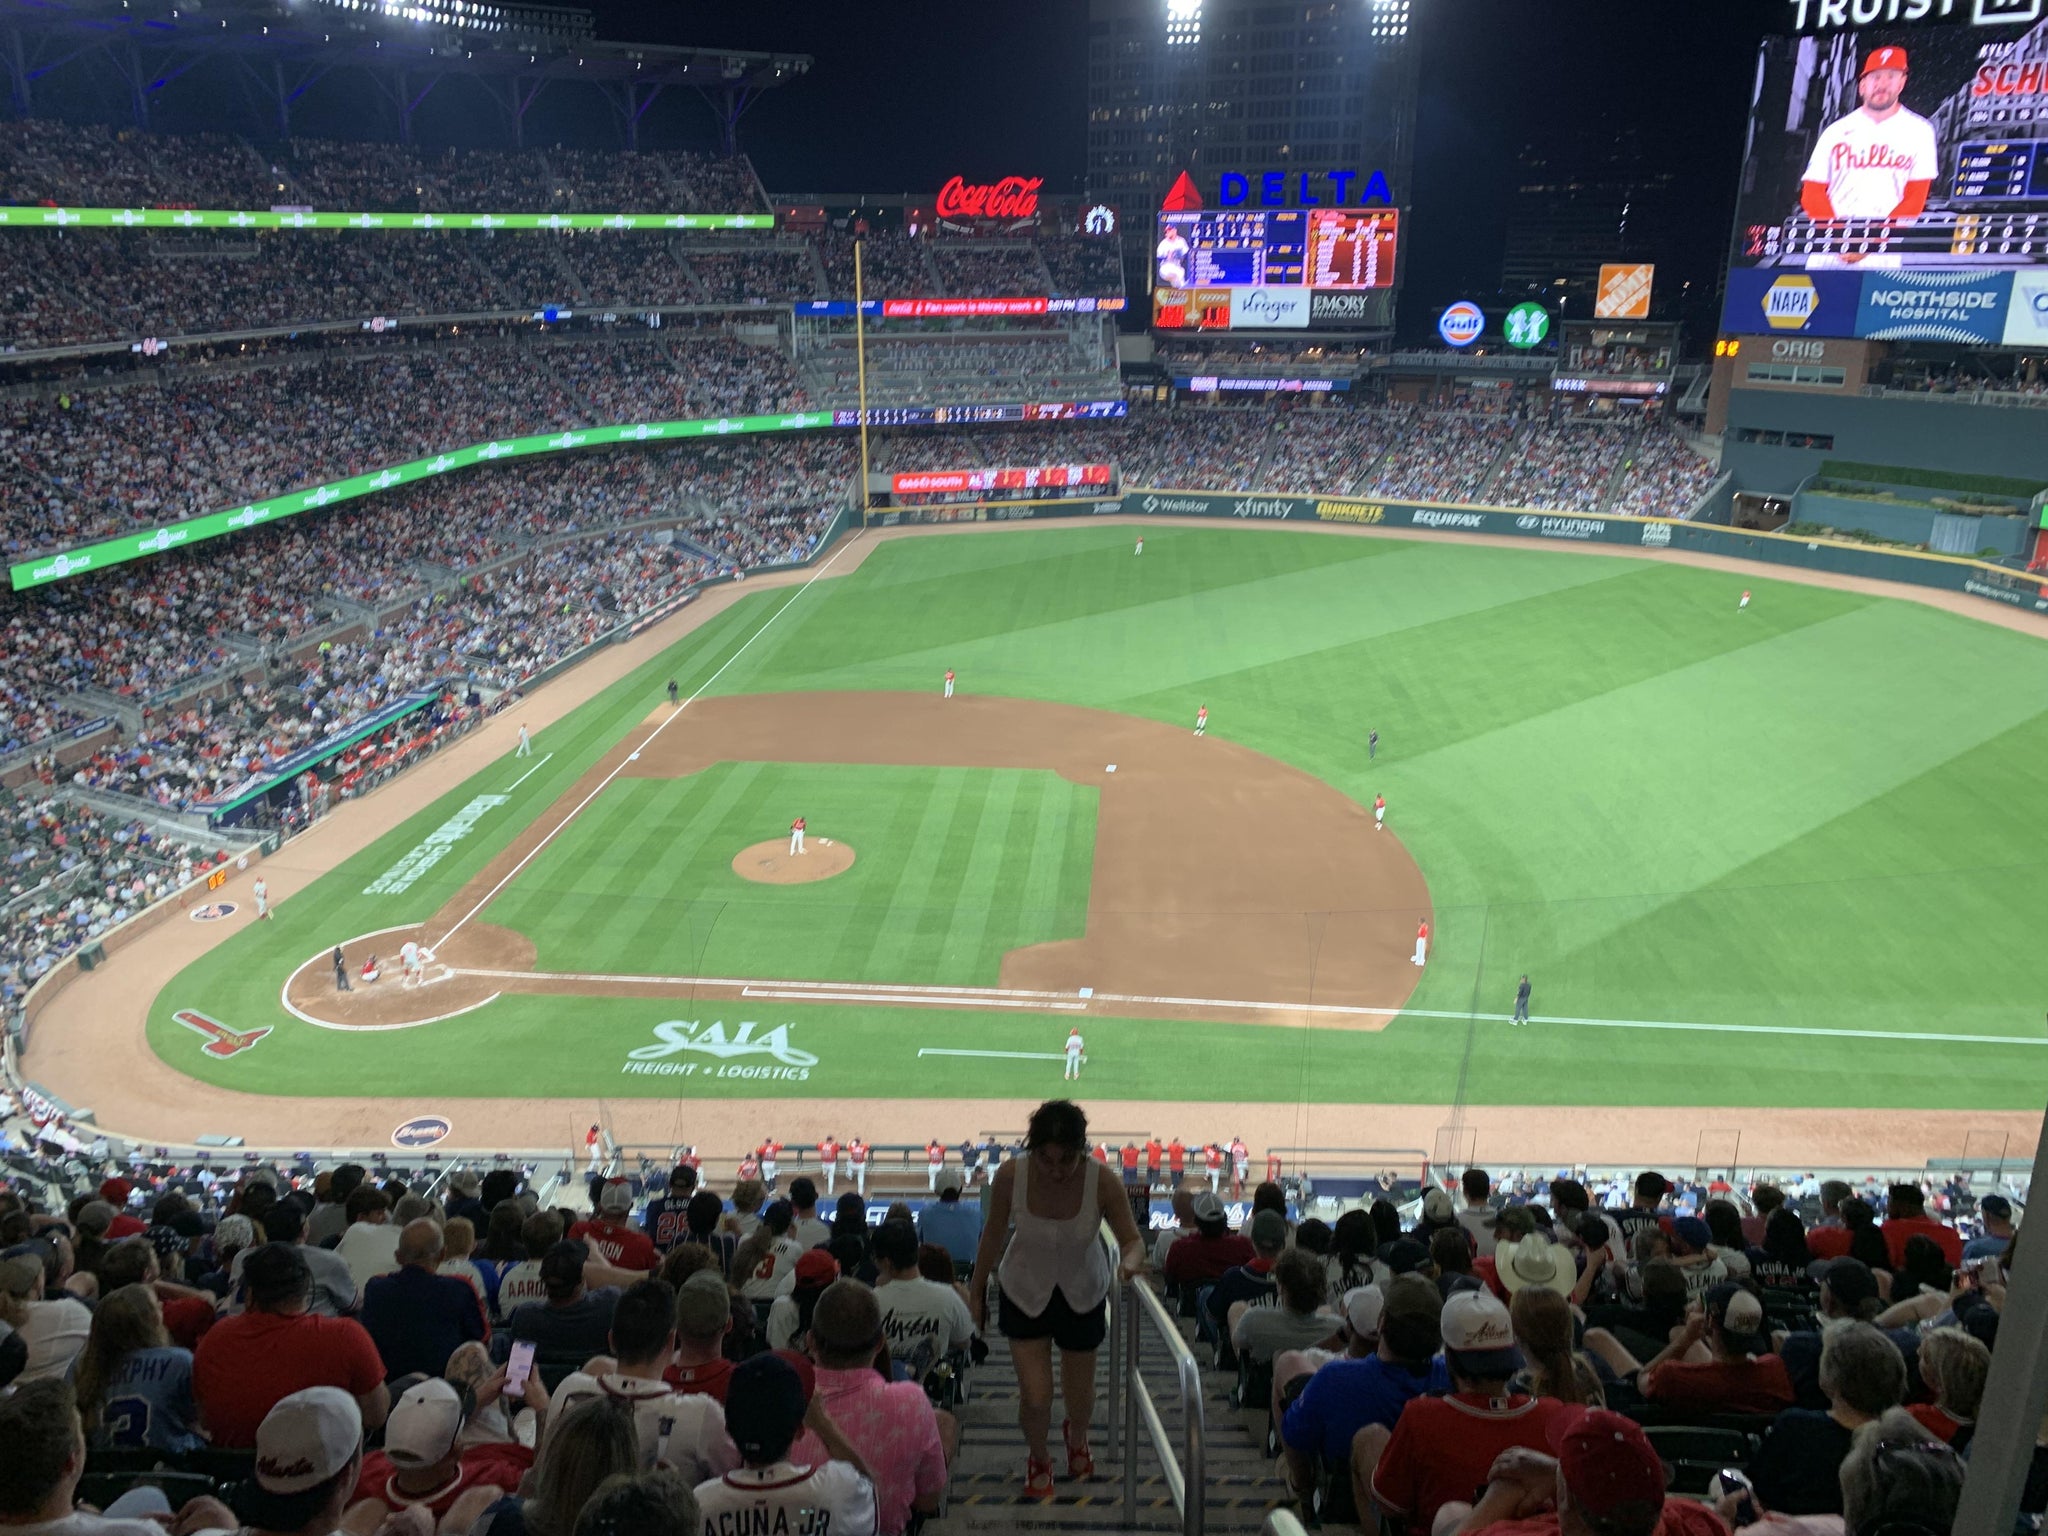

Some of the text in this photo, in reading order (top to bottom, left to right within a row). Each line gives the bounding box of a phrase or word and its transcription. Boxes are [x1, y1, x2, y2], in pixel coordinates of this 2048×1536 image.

[1971, 61, 2048, 97] SCH
[1831, 141, 1914, 171] Phillies
[1219, 169, 1393, 206] DELTA
[1241, 288, 1299, 323] Kroger
[1312, 295, 1368, 312] EMORY
[1770, 286, 1809, 316] NAPA
[1871, 290, 1998, 309] NORTHSIDE
[1443, 315, 1480, 330] Gulf
[1890, 308, 1970, 321] HOSPITAL
[899, 474, 964, 489] GAS SOUTH
[1160, 497, 1210, 514] Wellstar
[1232, 497, 1295, 519] xfinity
[1315, 501, 1386, 518] QUIKRETE
[1411, 509, 1481, 528] EQUIFAX
[1540, 516, 1606, 534] HYUNDAI
[627, 1019, 820, 1067] SAIA
[621, 1060, 810, 1081] FREIGHT LOGISTICS
[507, 1279, 549, 1299] AARO
[704, 1500, 790, 1536] ACUÑA
